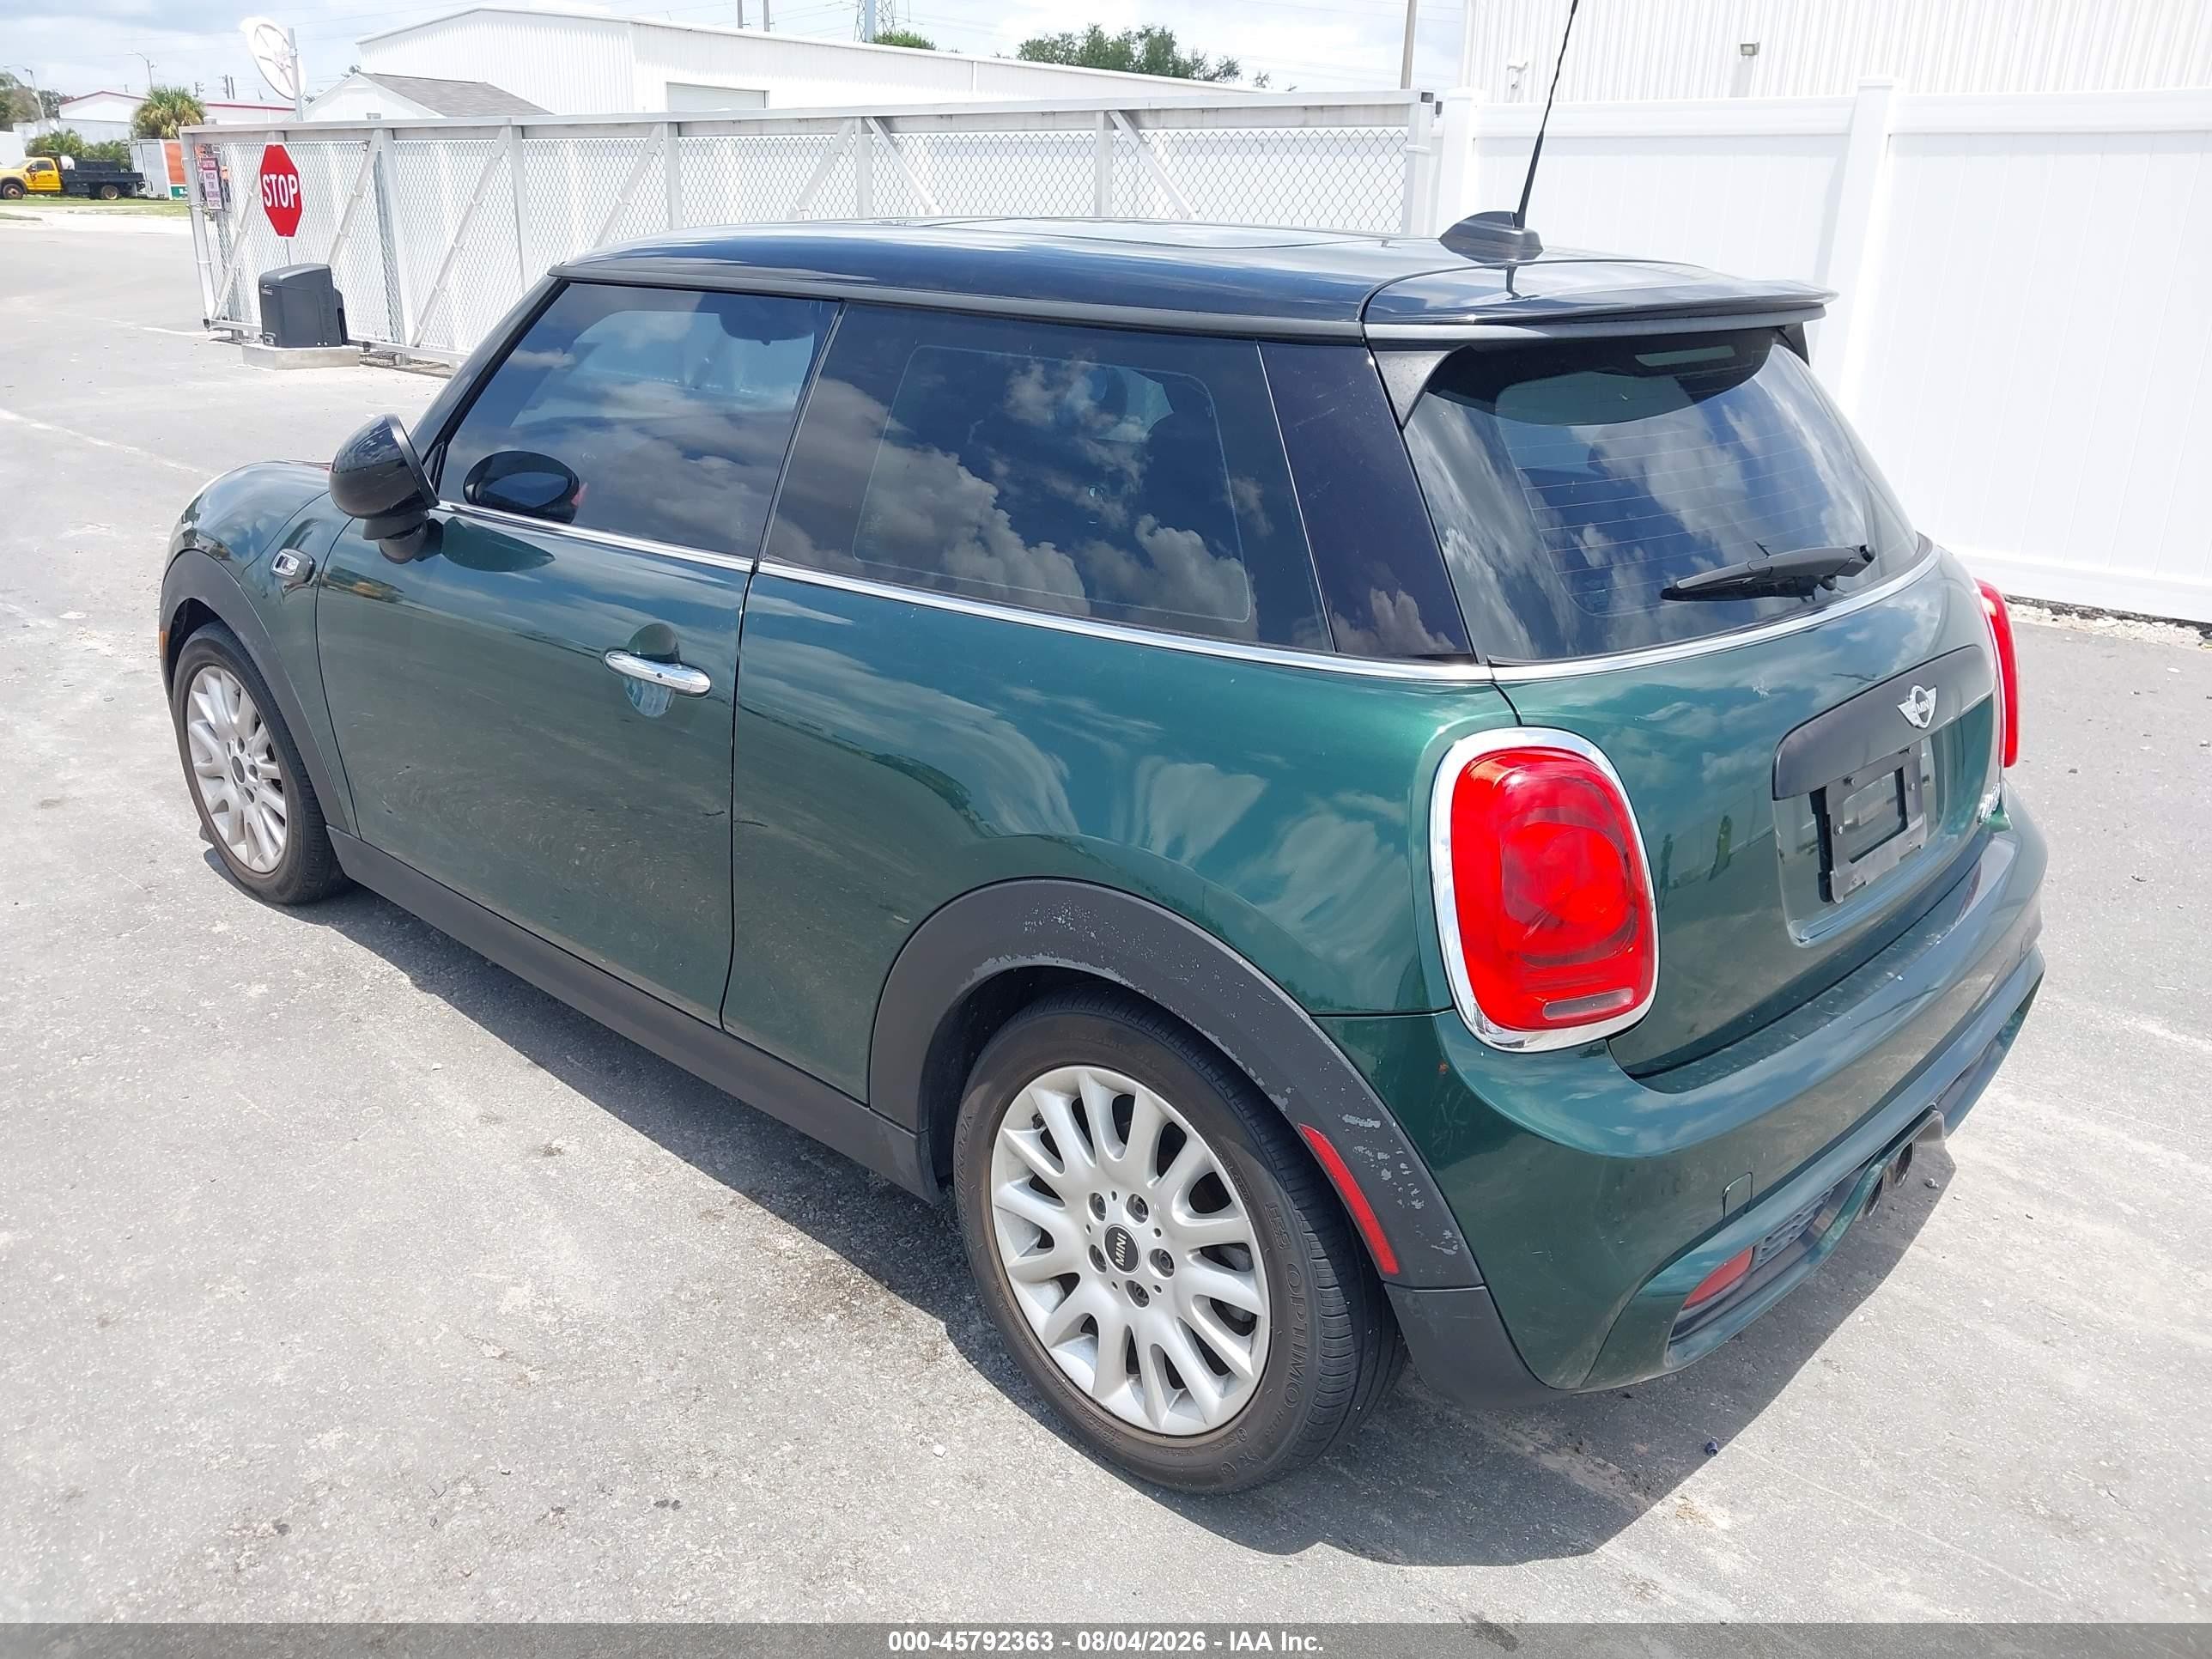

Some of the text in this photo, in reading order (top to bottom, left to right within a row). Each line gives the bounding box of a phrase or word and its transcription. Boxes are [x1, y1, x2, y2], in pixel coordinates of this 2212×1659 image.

[262, 173, 298, 209] STOP
[1115, 1231, 1127, 1267] MINI
[1283, 1262, 1308, 1409] OPTIMO
